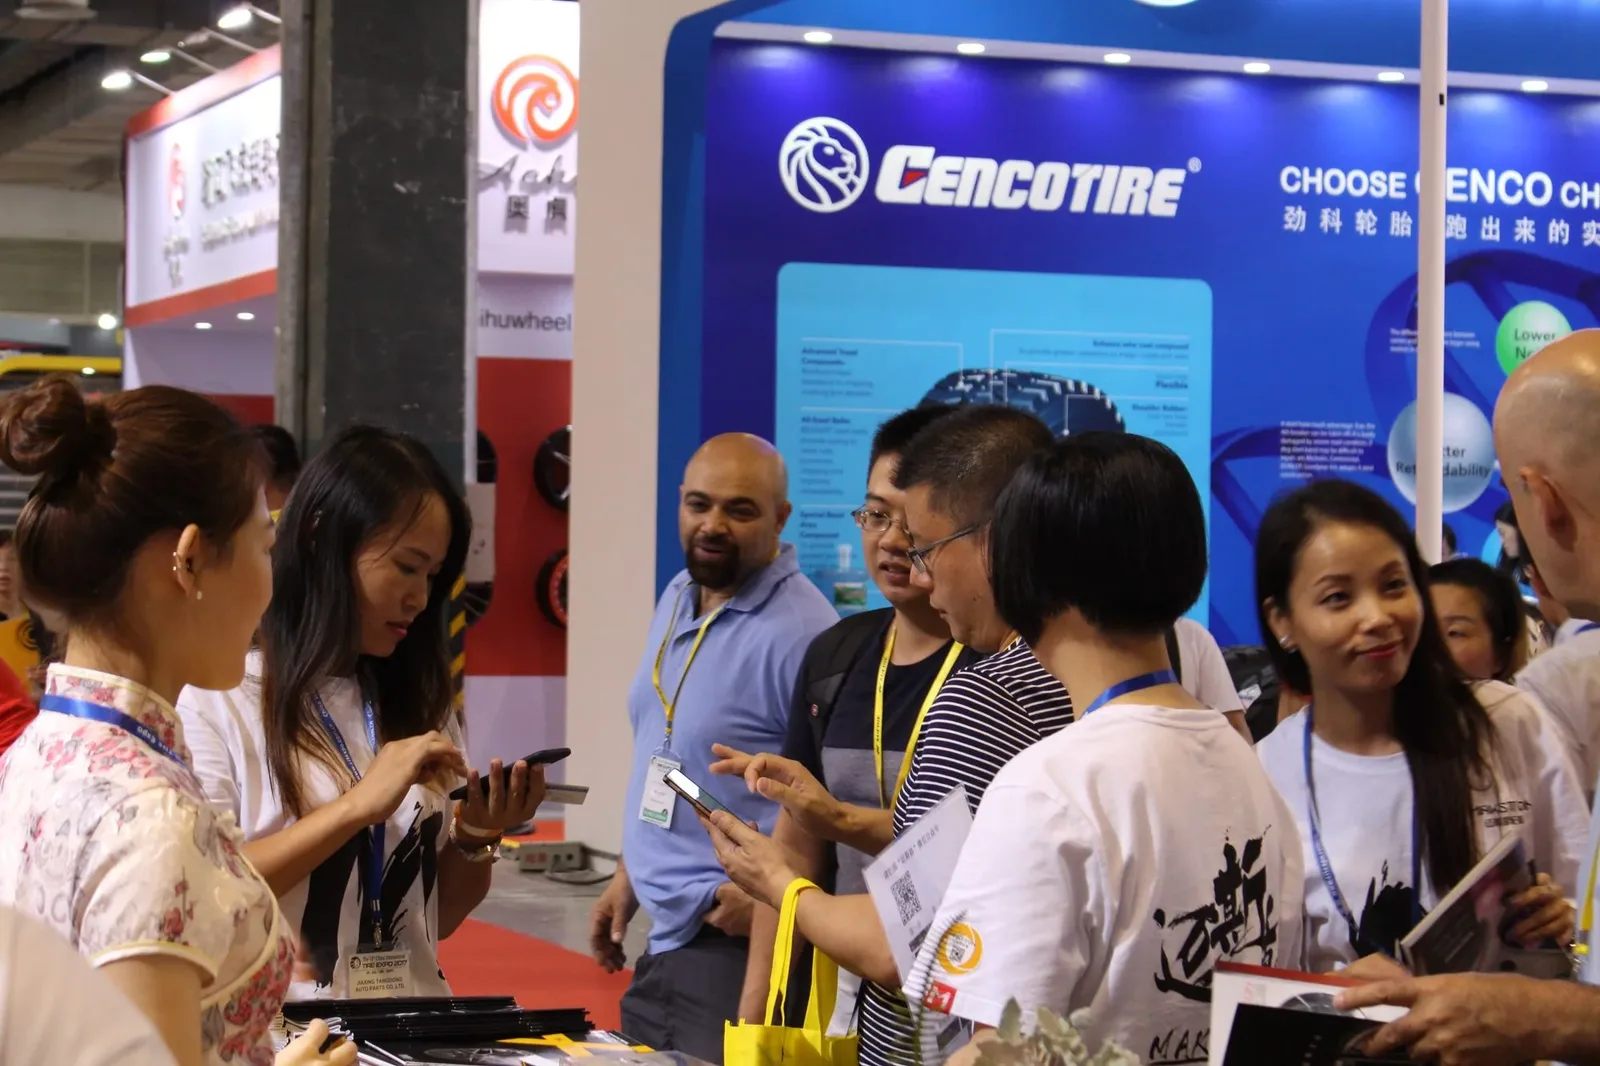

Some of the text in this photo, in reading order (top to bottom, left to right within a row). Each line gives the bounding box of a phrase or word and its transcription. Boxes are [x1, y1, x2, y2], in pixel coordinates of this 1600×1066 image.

[875, 145, 1187, 217] GENCOTIRE
[1280, 165, 1407, 199] CHOOSE
[1415, 167, 1553, 206] ENCO
[1283, 205, 1413, 237] 劲科轮胎
[1514, 328, 1556, 341] Lower
[375, 960, 393, 968] EXPO
